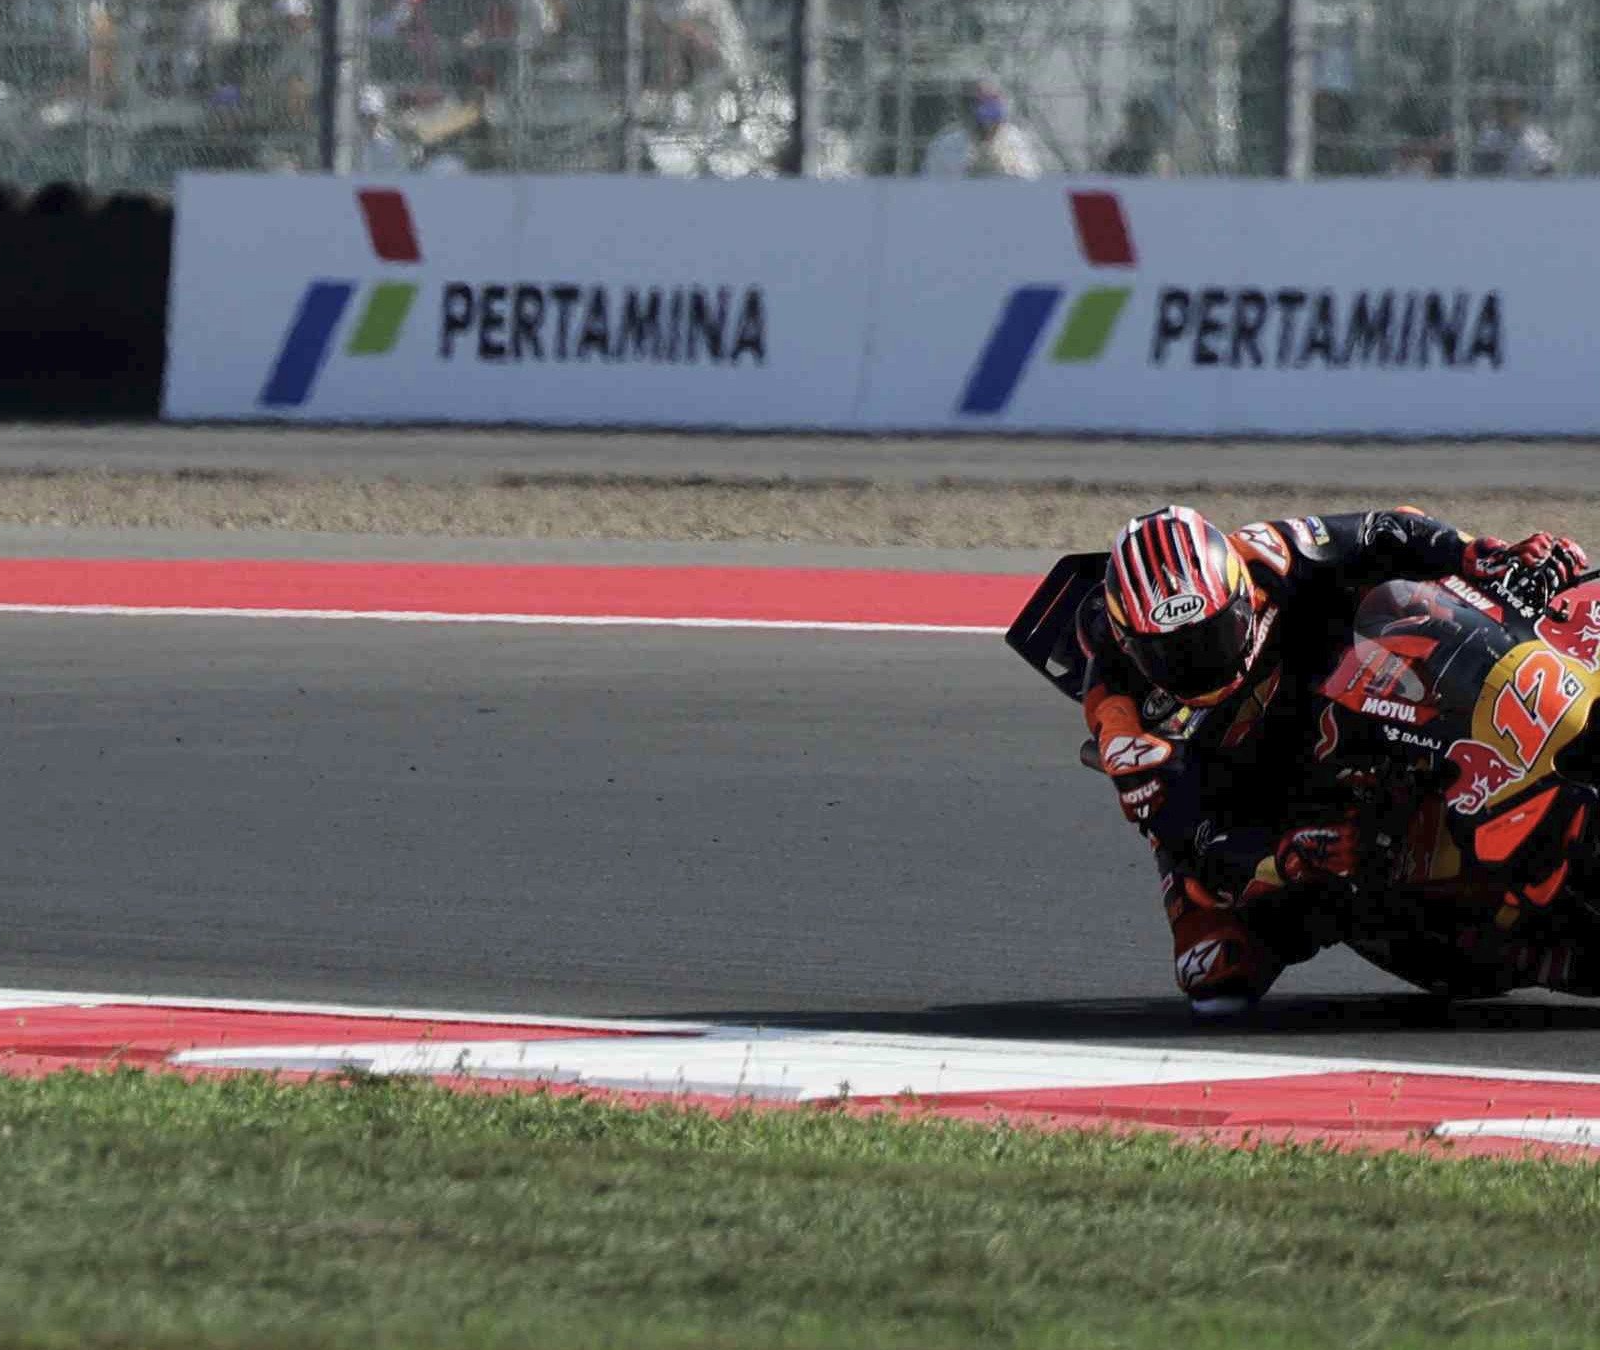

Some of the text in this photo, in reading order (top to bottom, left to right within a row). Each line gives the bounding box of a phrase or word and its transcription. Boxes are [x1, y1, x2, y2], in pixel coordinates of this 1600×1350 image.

[440, 282, 767, 364] PERTAMINA
[1150, 287, 1504, 368] PERTAMINA
[1158, 598, 1198, 620] Arai
[1361, 697, 1417, 722] MOTUL
[1493, 649, 1578, 771] 12
